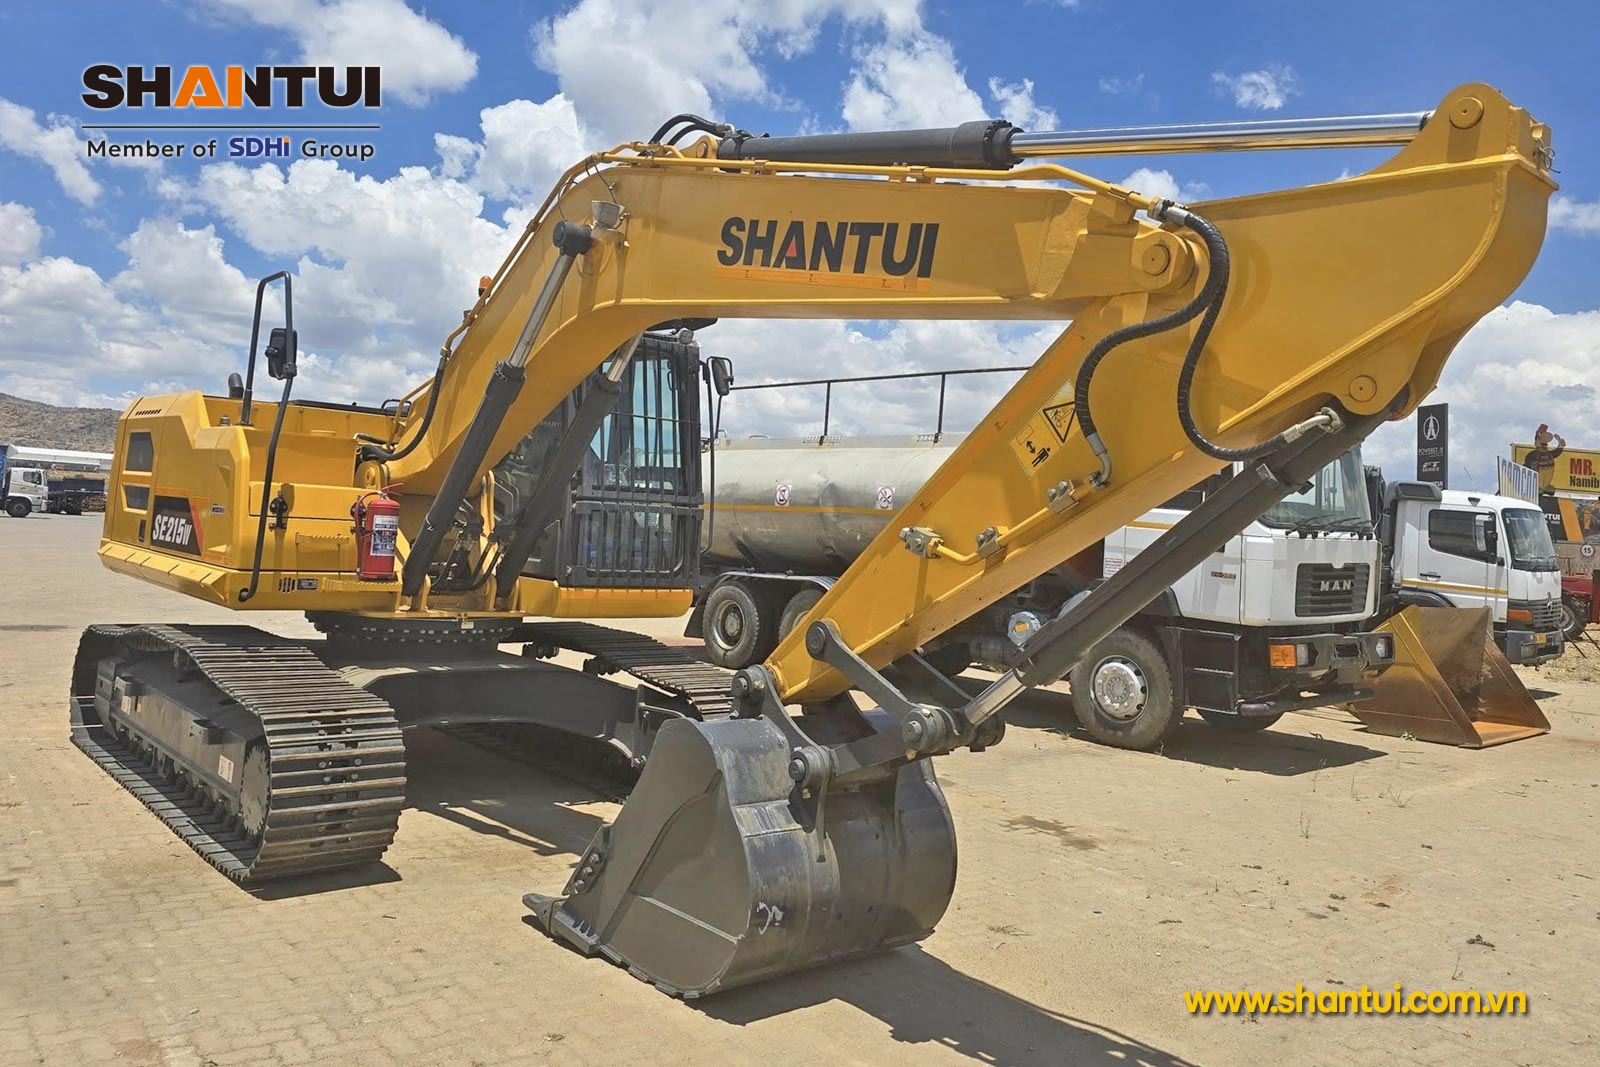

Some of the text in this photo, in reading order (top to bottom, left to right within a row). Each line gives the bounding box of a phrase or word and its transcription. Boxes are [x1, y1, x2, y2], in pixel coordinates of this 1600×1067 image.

[717, 216, 940, 279] SHANTUI
[1569, 457, 1596, 476] MR.
[1320, 579, 1352, 592] MAN
